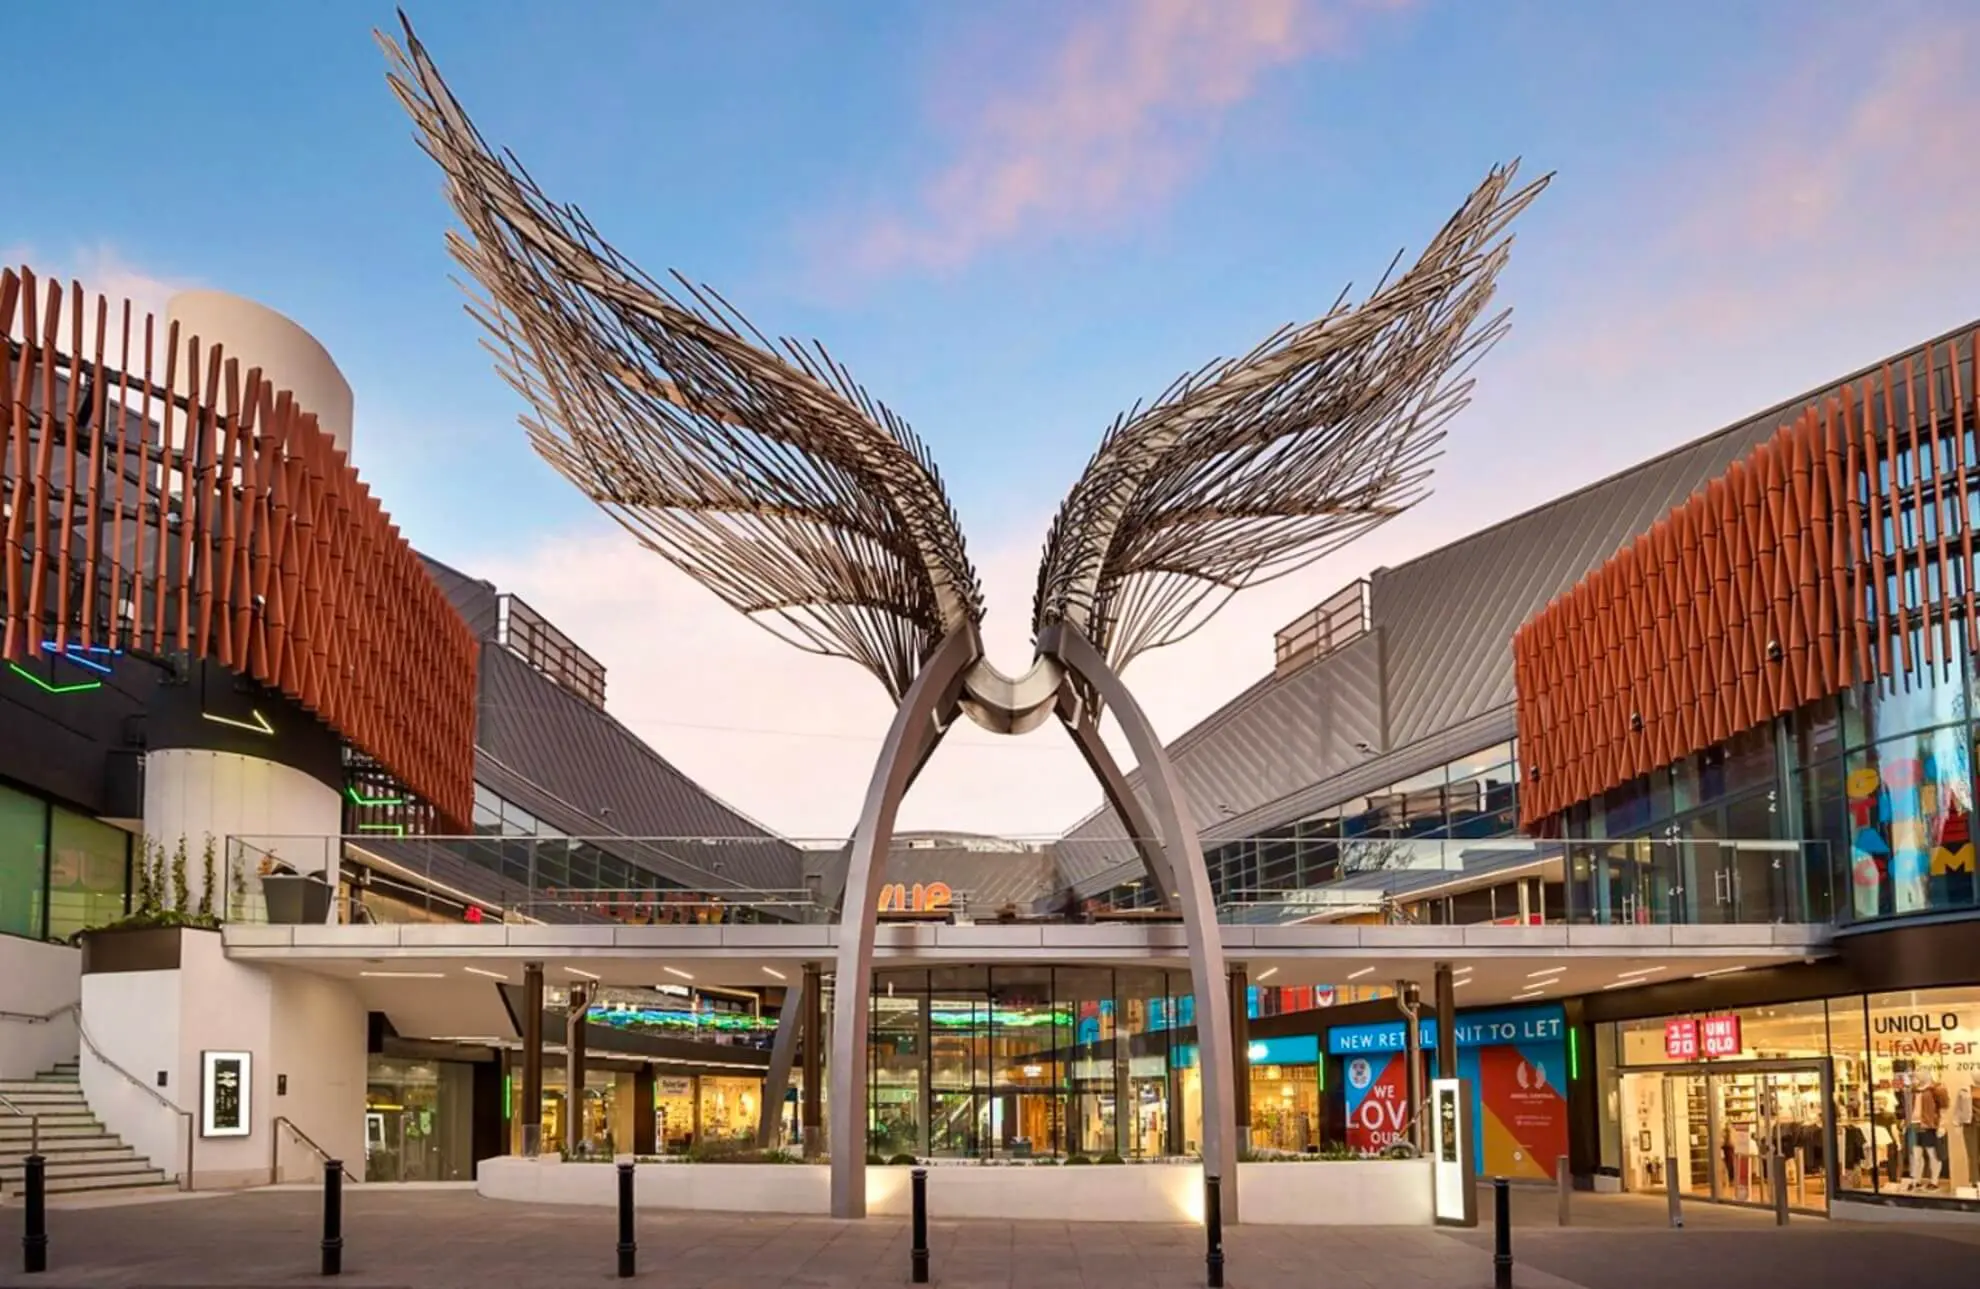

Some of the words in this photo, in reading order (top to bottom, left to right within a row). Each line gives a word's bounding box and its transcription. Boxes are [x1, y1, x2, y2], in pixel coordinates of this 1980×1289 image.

[1340, 1033, 1374, 1049] NEW
[1378, 1029, 1433, 1048] RETIL
[1455, 1024, 1483, 1042] NIT
[1488, 1022, 1517, 1040] TO
[1524, 1018, 1560, 1038] LET
[1705, 1020, 1731, 1037] UNI
[1875, 1012, 1959, 1034] UNIQLO
[1707, 1036, 1735, 1055] QLO
[1876, 1037, 1978, 1058] LifeWear
[1373, 1085, 1395, 1098] WE
[1345, 1100, 1408, 1130] LOV
